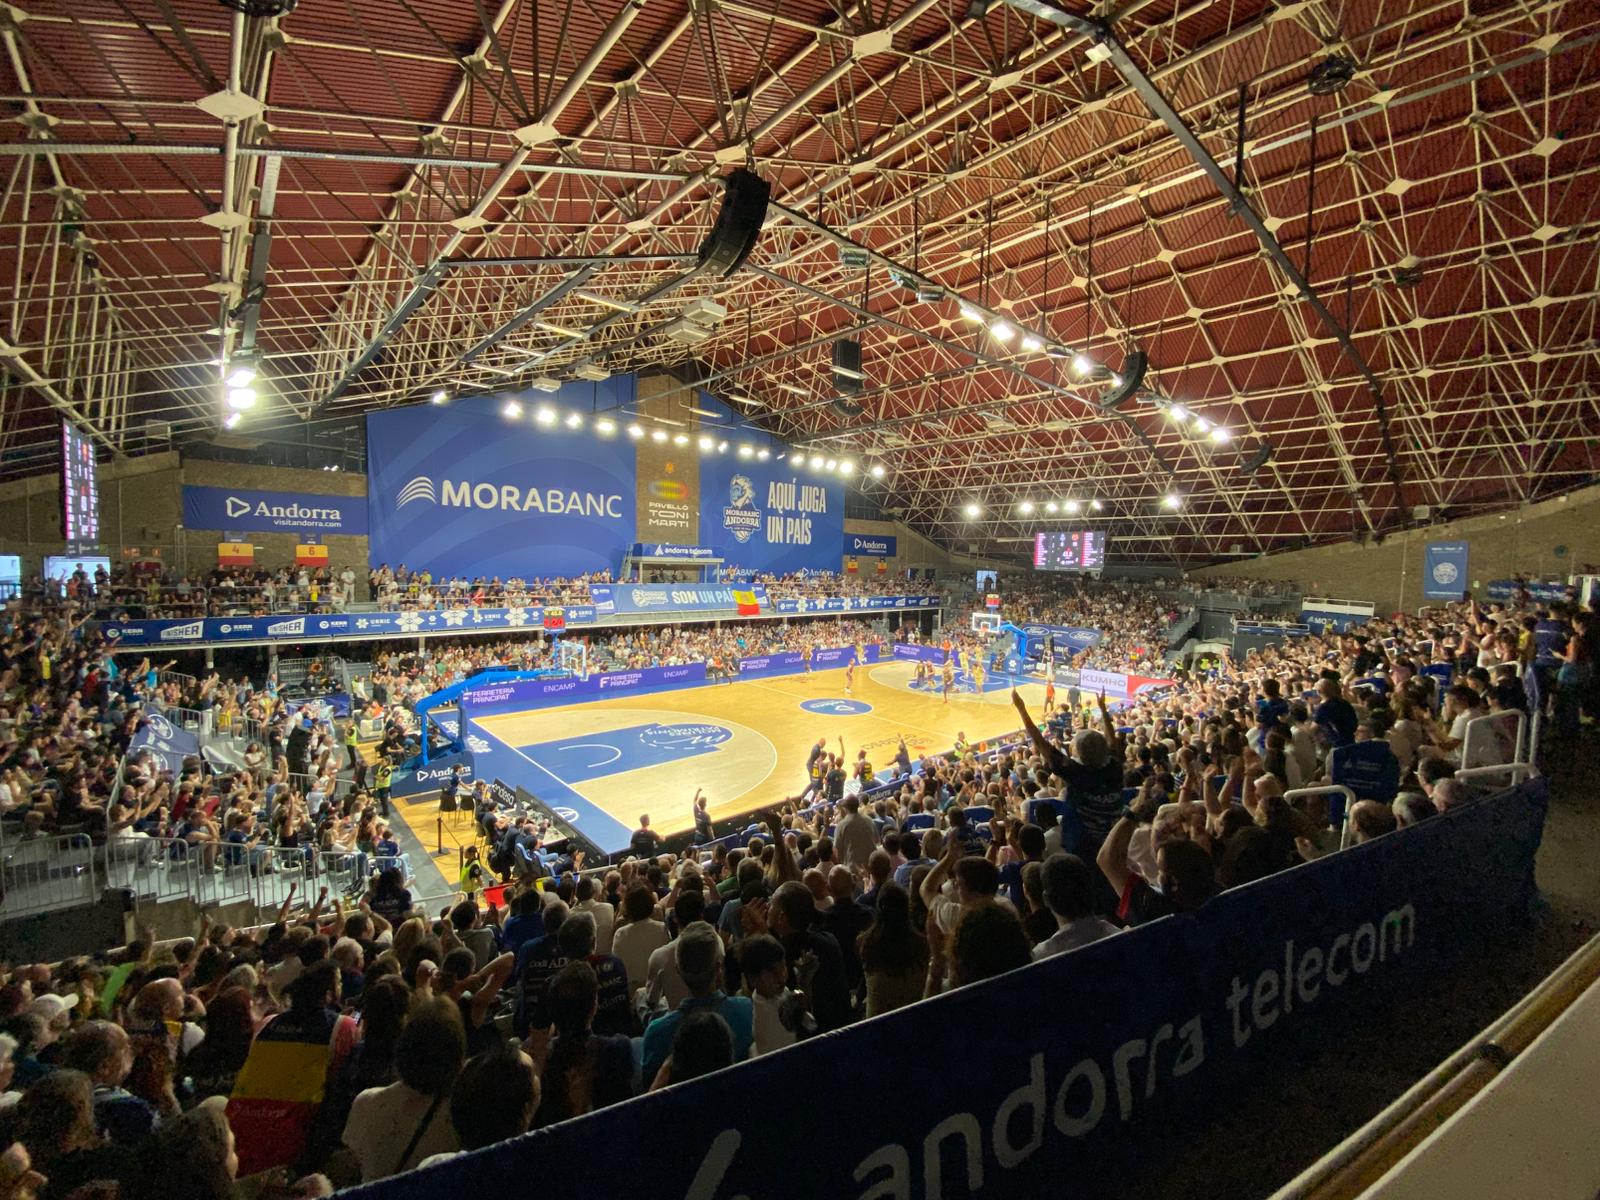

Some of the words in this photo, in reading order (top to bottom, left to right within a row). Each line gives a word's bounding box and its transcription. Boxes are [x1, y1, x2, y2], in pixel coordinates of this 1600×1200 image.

[441, 479, 622, 518] MORABANC
[767, 477, 797, 514] AQUÍ
[798, 485, 827, 513] JUGA
[253, 501, 342, 520] Andorra
[649, 509, 689, 519] TONI
[725, 509, 760, 518] MORABANC
[273, 518, 342, 528] visitandorra.com
[725, 516, 760, 528] ANDORRA
[767, 515, 784, 544] UN
[786, 511, 812, 545] PAÍS
[232, 544, 240, 554] 4
[862, 540, 888, 550] Andorra
[308, 546, 316, 556] 6
[671, 590, 698, 605] SOM
[699, 589, 716, 604] UN
[663, 669, 689, 678] ENCAMP
[1082, 674, 1127, 687] KUMHO
[472, 686, 516, 698] FERRETERIA
[543, 682, 576, 693] ENCAMP
[472, 693, 510, 704] PRINCIPAT
[1225, 900, 1416, 1048] telecom
